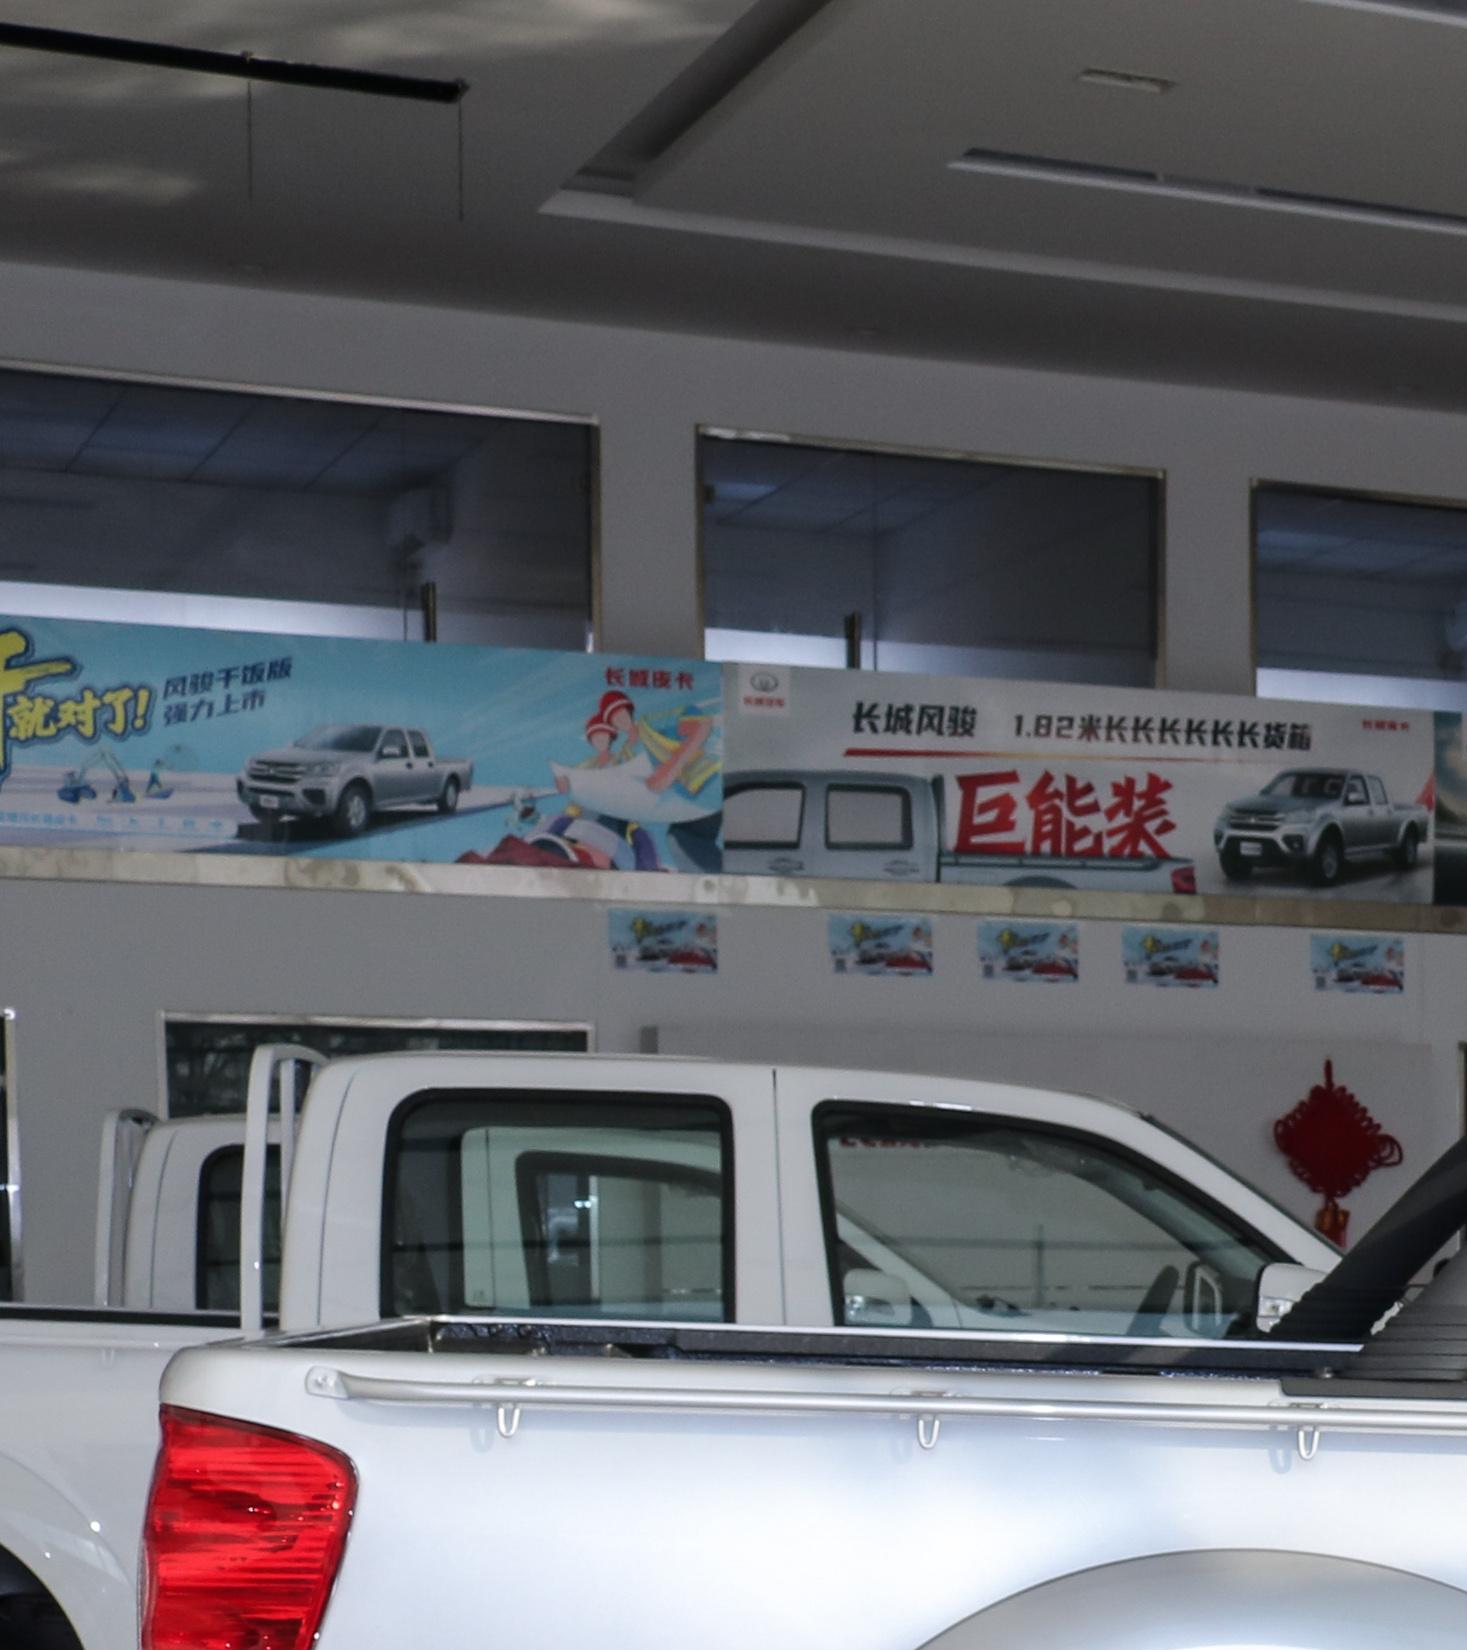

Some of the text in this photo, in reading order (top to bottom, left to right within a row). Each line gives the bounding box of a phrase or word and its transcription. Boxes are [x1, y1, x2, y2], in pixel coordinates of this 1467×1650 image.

[163, 656, 293, 699] 风骏干饭版
[164, 689, 266, 726] 强力上市
[852, 701, 978, 738] 长城风骏
[953, 770, 1178, 859] 巨能装
